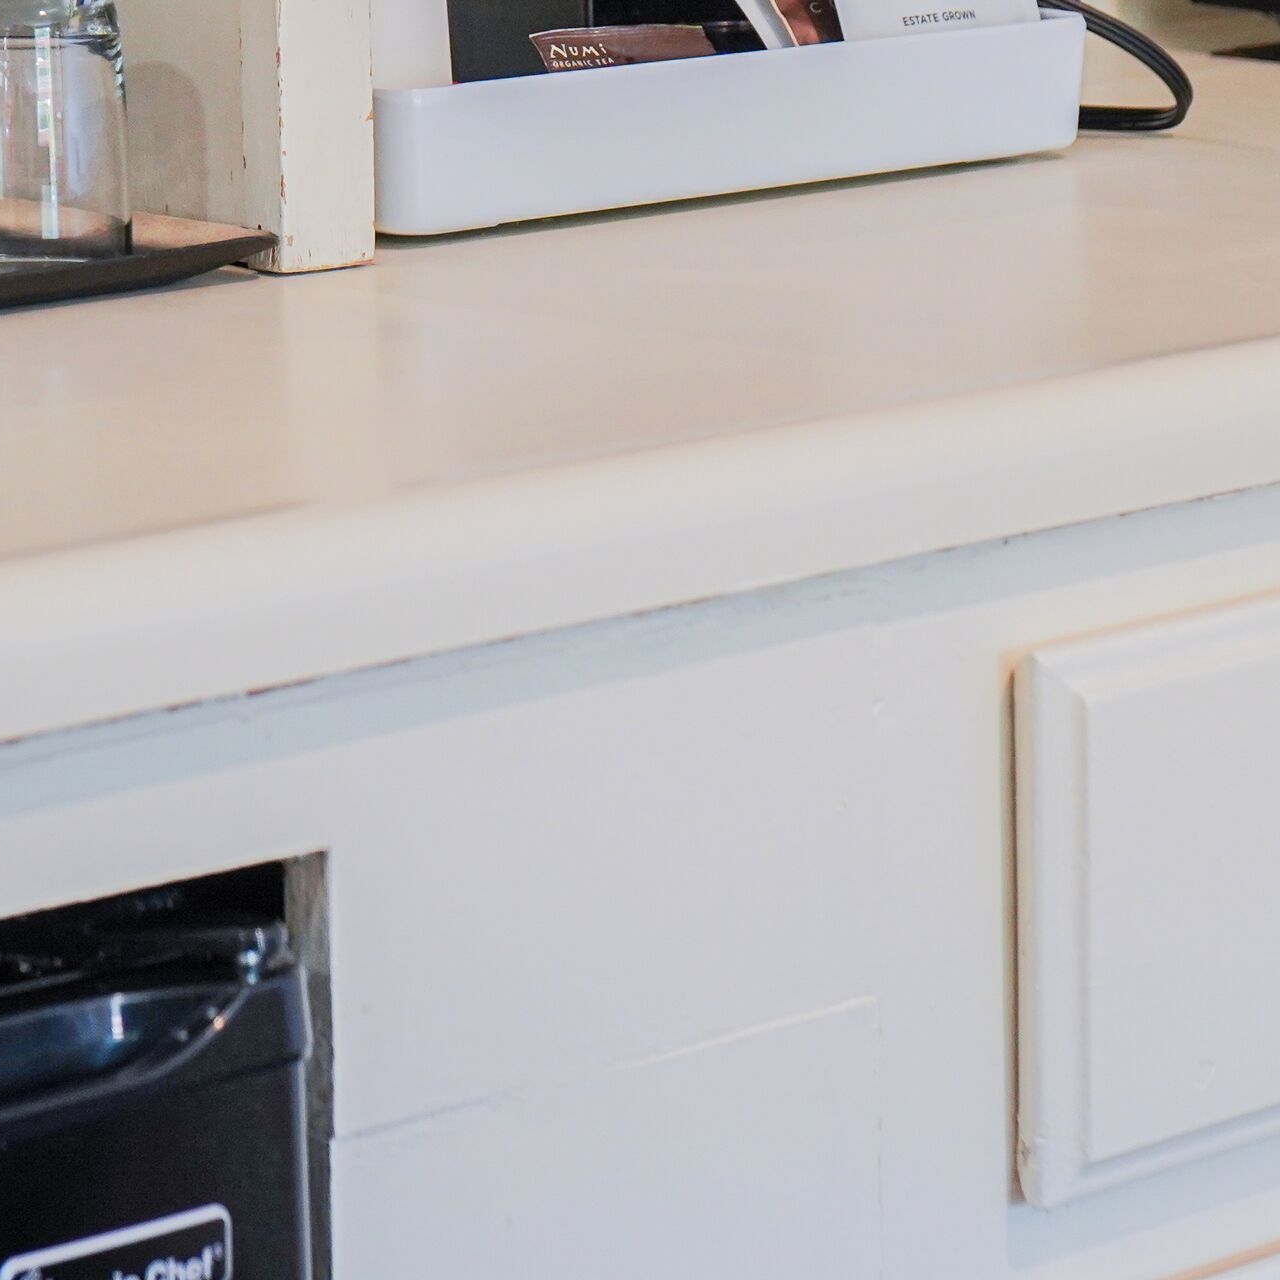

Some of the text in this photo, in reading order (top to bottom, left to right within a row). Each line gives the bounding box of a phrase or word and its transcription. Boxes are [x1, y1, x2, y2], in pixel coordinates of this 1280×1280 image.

[902, 10, 976, 27] ESTATE GROWN
[552, 57, 615, 69] ORGANIC TEA
